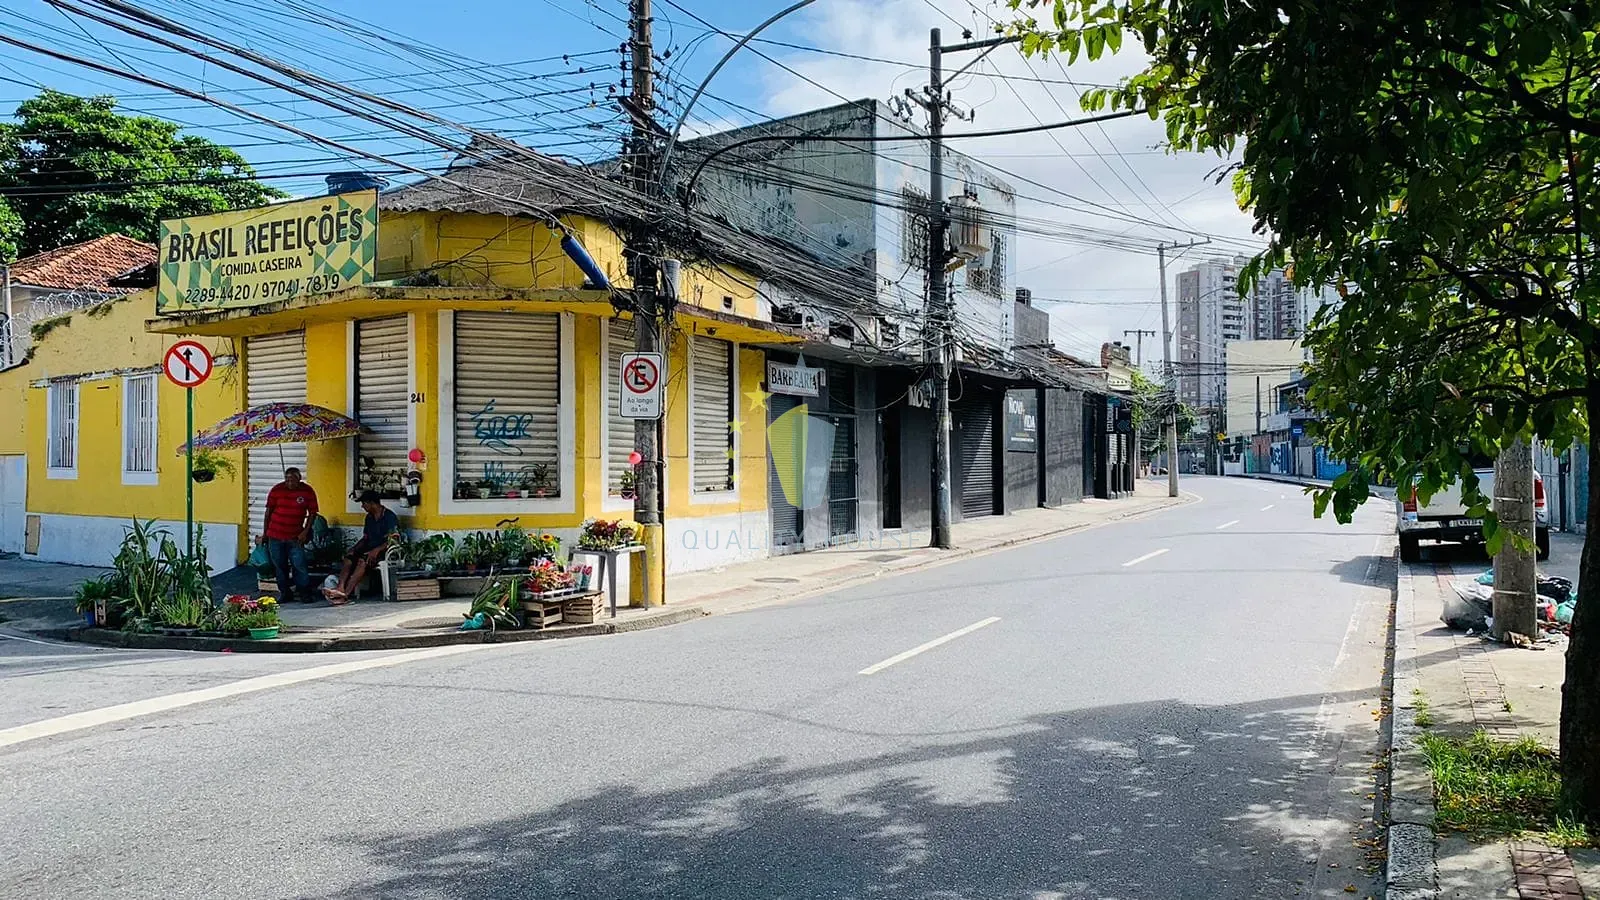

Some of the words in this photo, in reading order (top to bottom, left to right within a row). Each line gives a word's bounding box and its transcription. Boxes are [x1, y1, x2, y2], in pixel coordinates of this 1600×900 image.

[168, 227, 238, 263] BRASIL
[245, 204, 363, 257] REFEIÇÕES
[221, 261, 258, 277] COMIDA
[259, 256, 302, 273] CASEIRA
[184, 284, 251, 303] 2289-4420
[252, 282, 259, 299] /
[261, 273, 340, 298] 97041-7819
[771, 366, 818, 390] BARBEARIA
[410, 393, 425, 403] 241
[636, 397, 653, 405] longo
